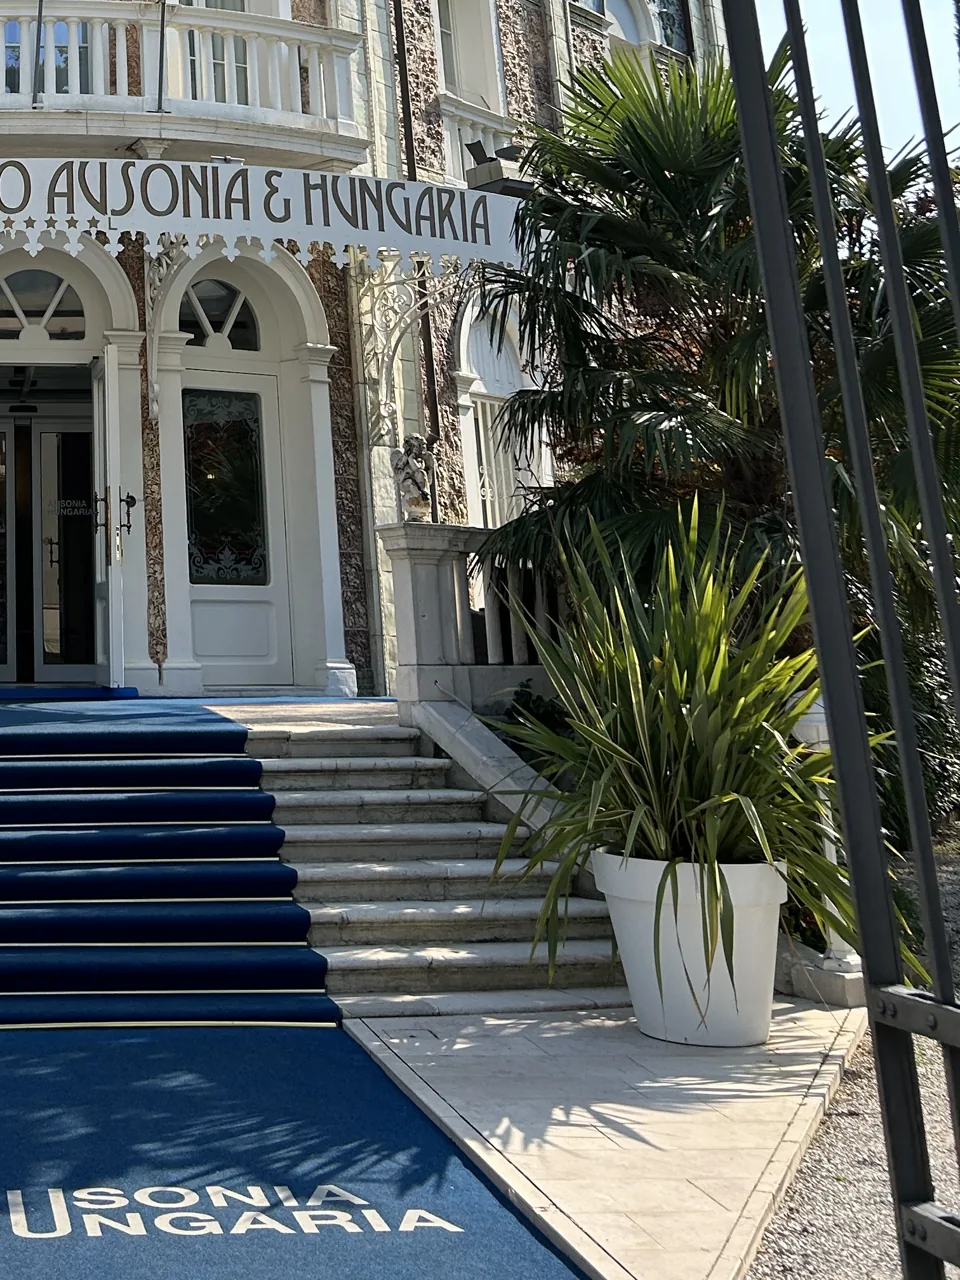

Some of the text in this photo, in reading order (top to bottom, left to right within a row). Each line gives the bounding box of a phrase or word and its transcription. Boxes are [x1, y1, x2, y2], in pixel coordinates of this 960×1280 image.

[47, 160, 251, 221] AUSONIA
[263, 170, 291, 223] &
[302, 172, 492, 246] HUNGARIA
